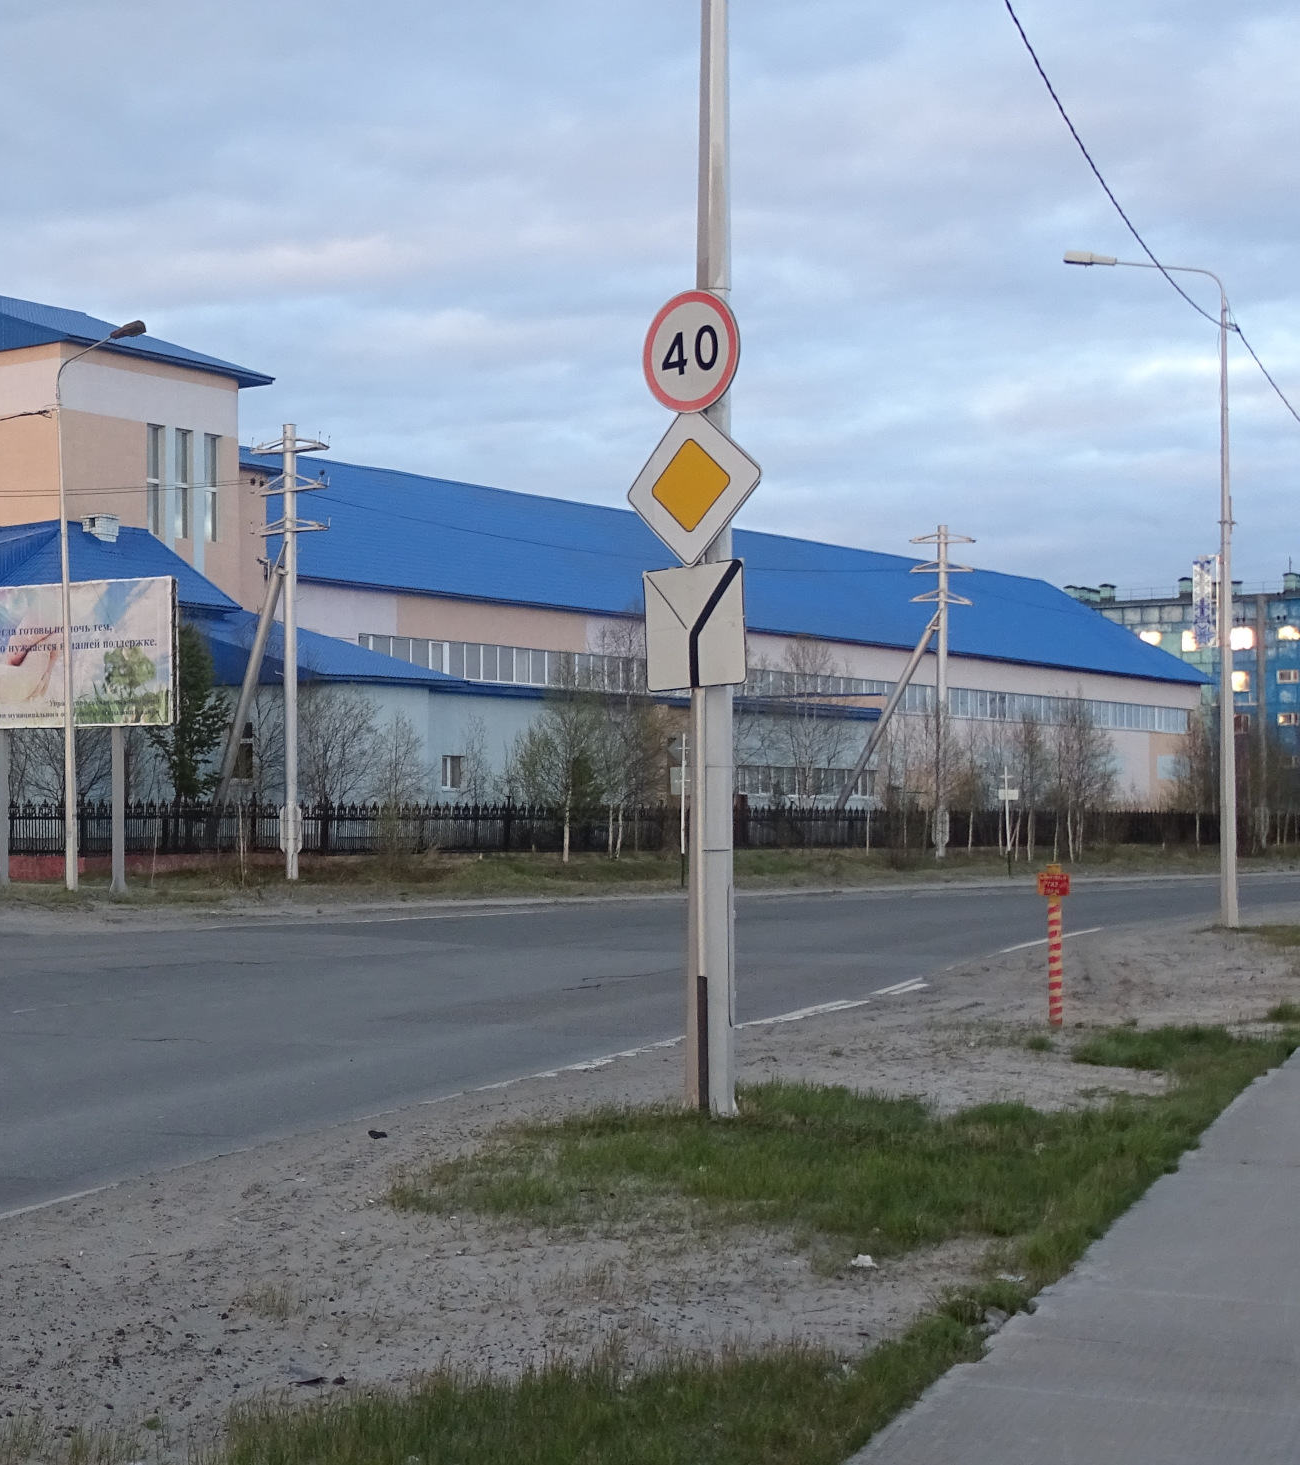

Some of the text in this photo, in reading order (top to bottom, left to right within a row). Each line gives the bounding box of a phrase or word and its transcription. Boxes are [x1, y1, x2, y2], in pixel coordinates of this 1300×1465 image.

[662, 325, 718, 376] 40
[19, 626, 51, 636] готовы
[8, 643, 56, 653] нуждается
[103, 638, 157, 649] поддержке.
